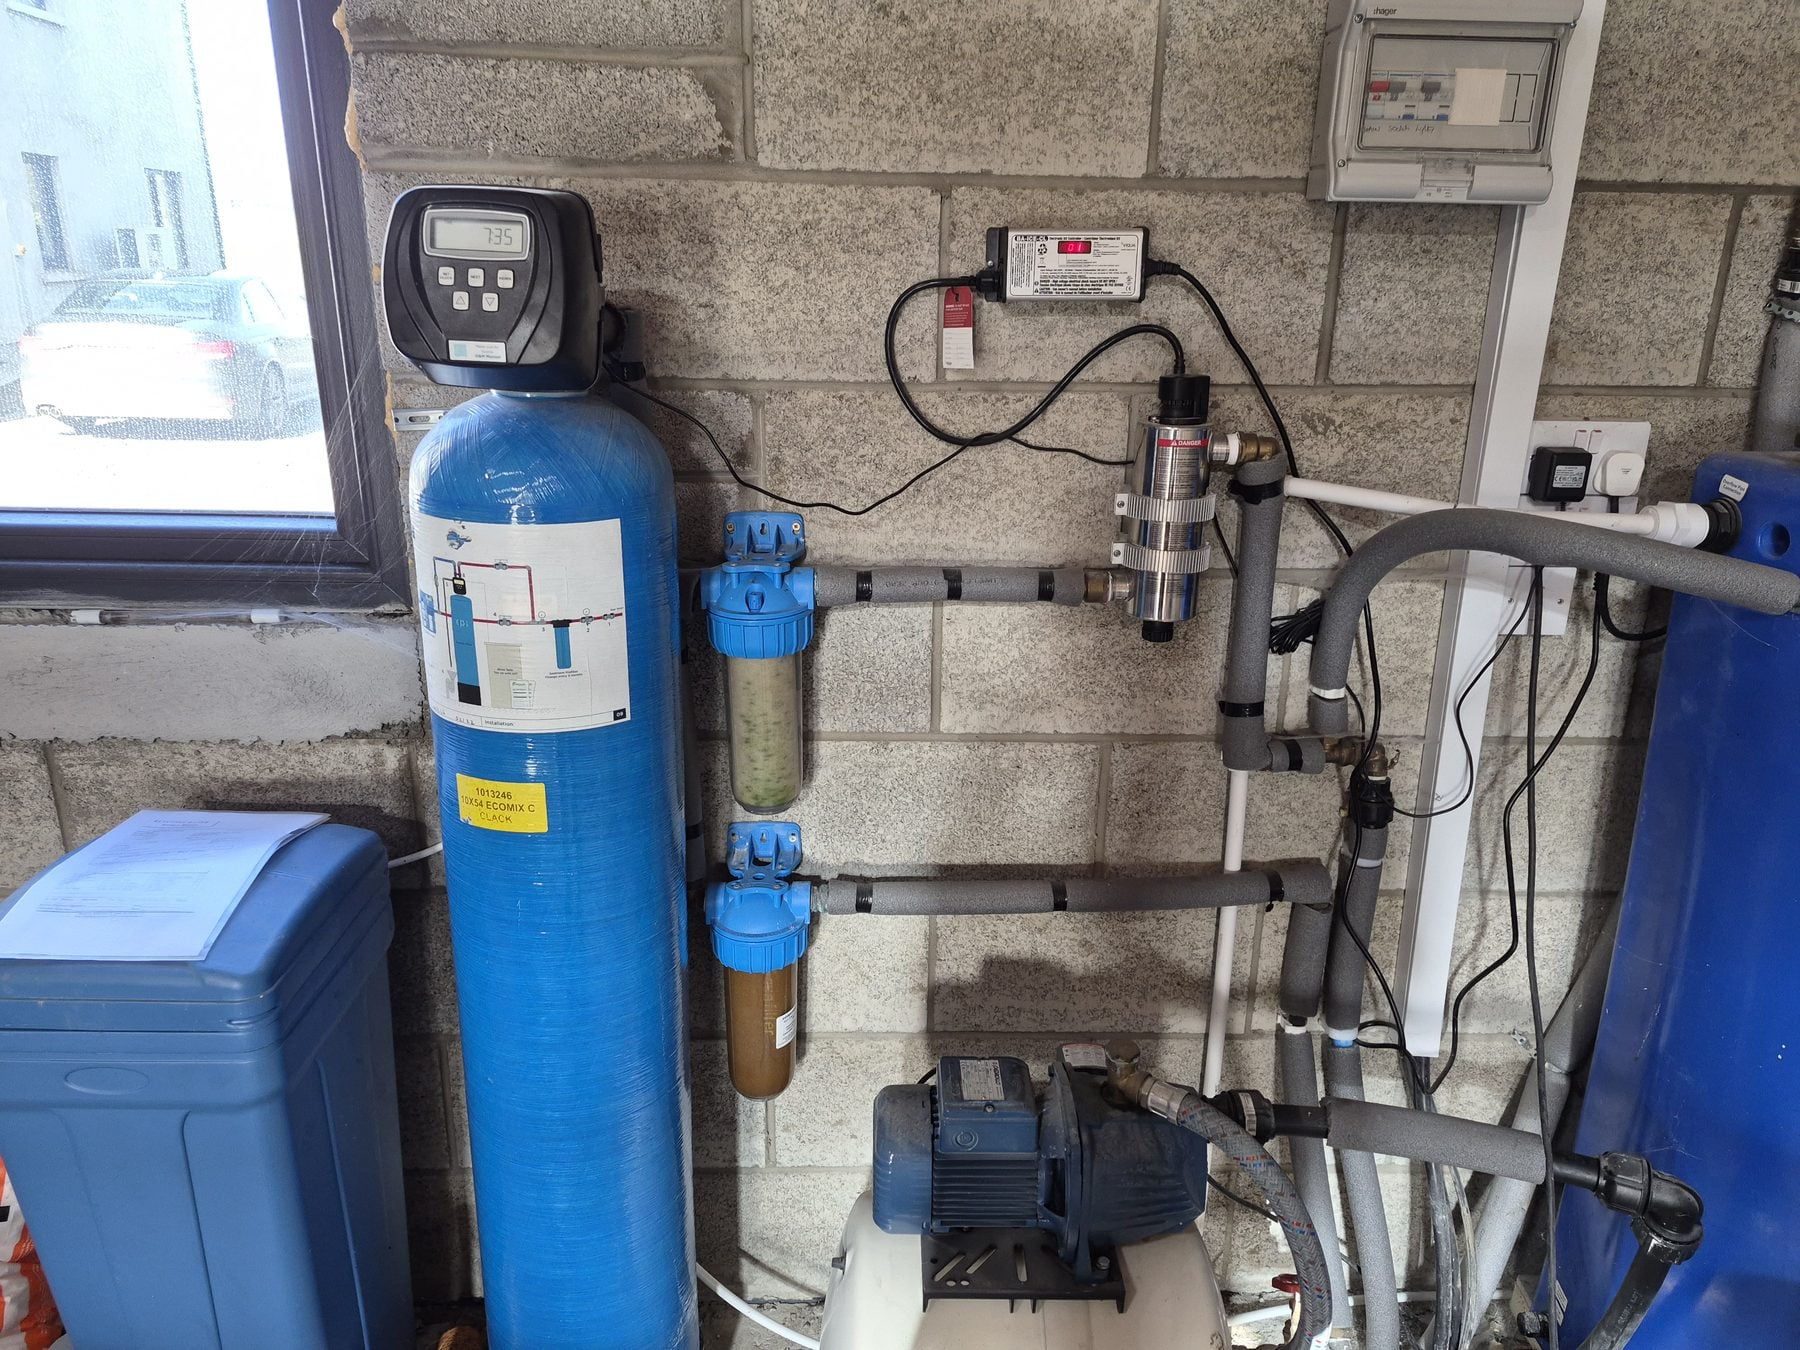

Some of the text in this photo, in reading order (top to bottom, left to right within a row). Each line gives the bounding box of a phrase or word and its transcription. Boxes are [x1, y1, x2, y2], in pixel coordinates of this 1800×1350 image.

[484, 719, 514, 727] Installation
[476, 787, 512, 800] 1013246
[461, 795, 535, 813] 10X54 ECOMIX C
[479, 811, 513, 824] CLACK
